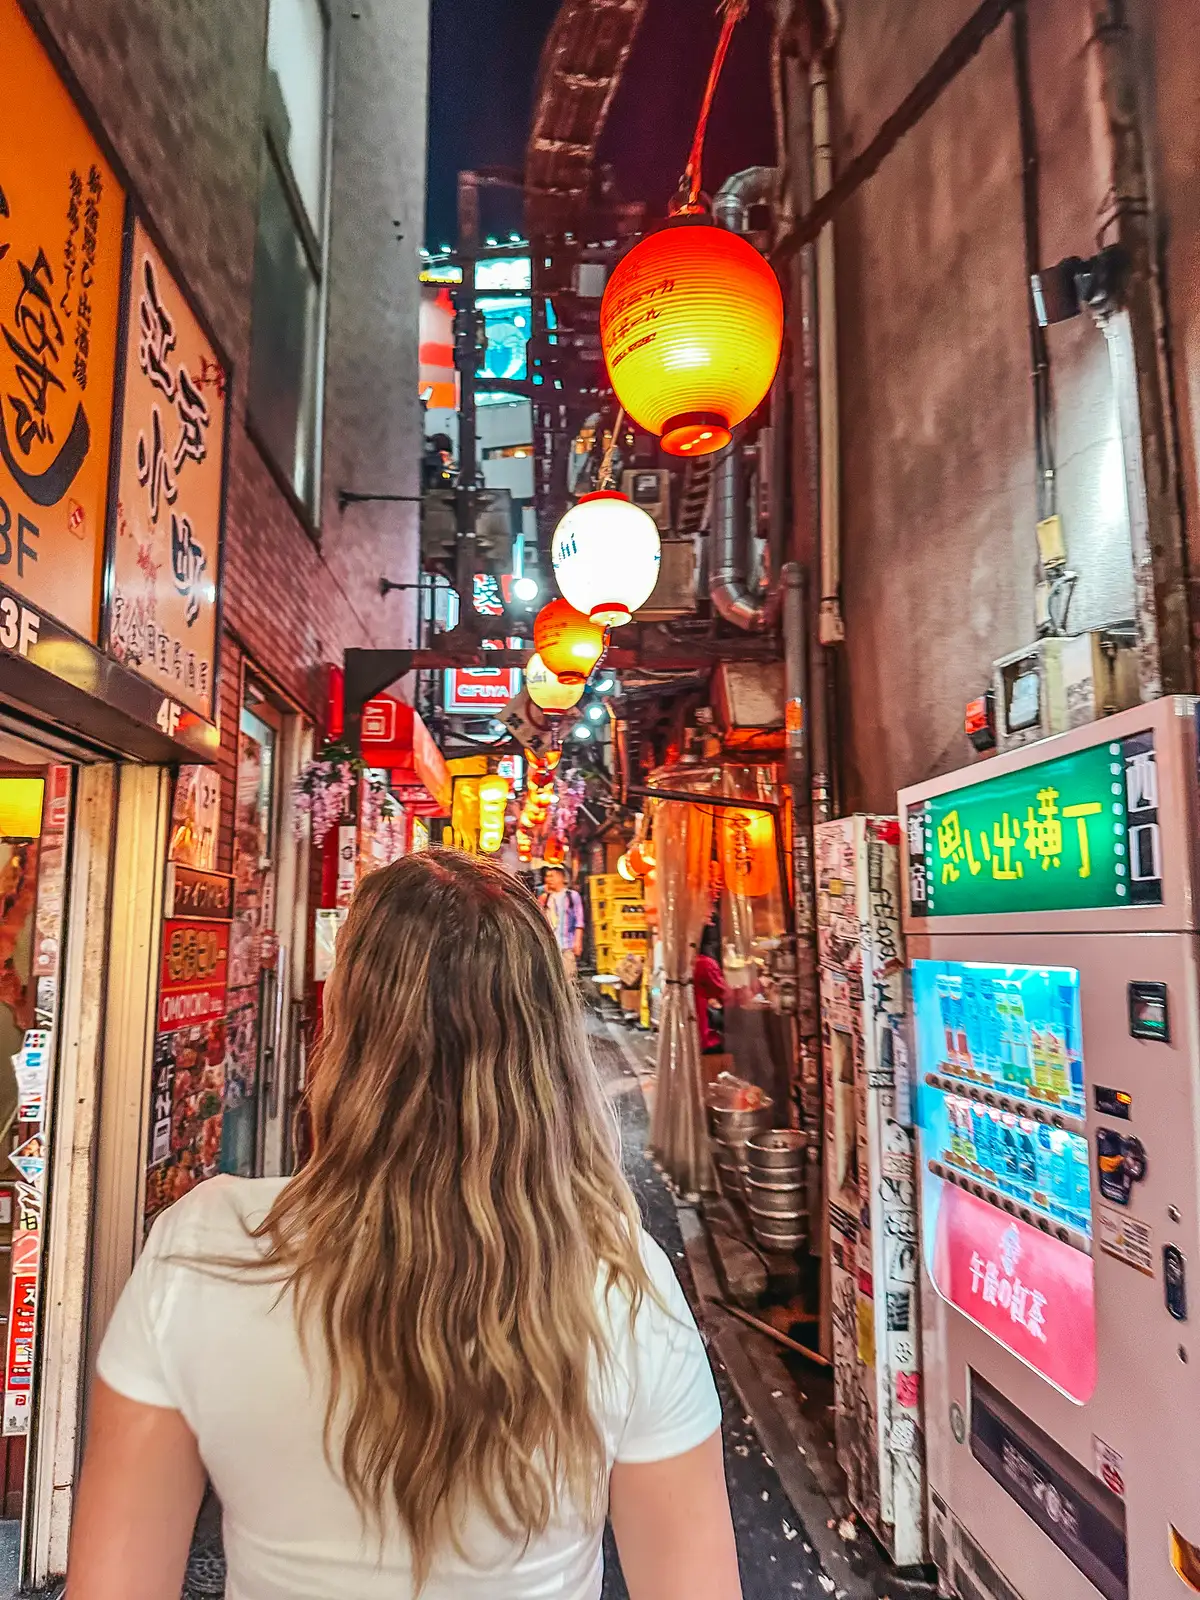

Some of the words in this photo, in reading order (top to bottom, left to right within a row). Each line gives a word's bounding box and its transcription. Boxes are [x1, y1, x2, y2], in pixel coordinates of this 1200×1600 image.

[0, 597, 40, 657] 3F
[157, 697, 182, 738] 4F
[936, 786, 1103, 885] 思い出横丁
